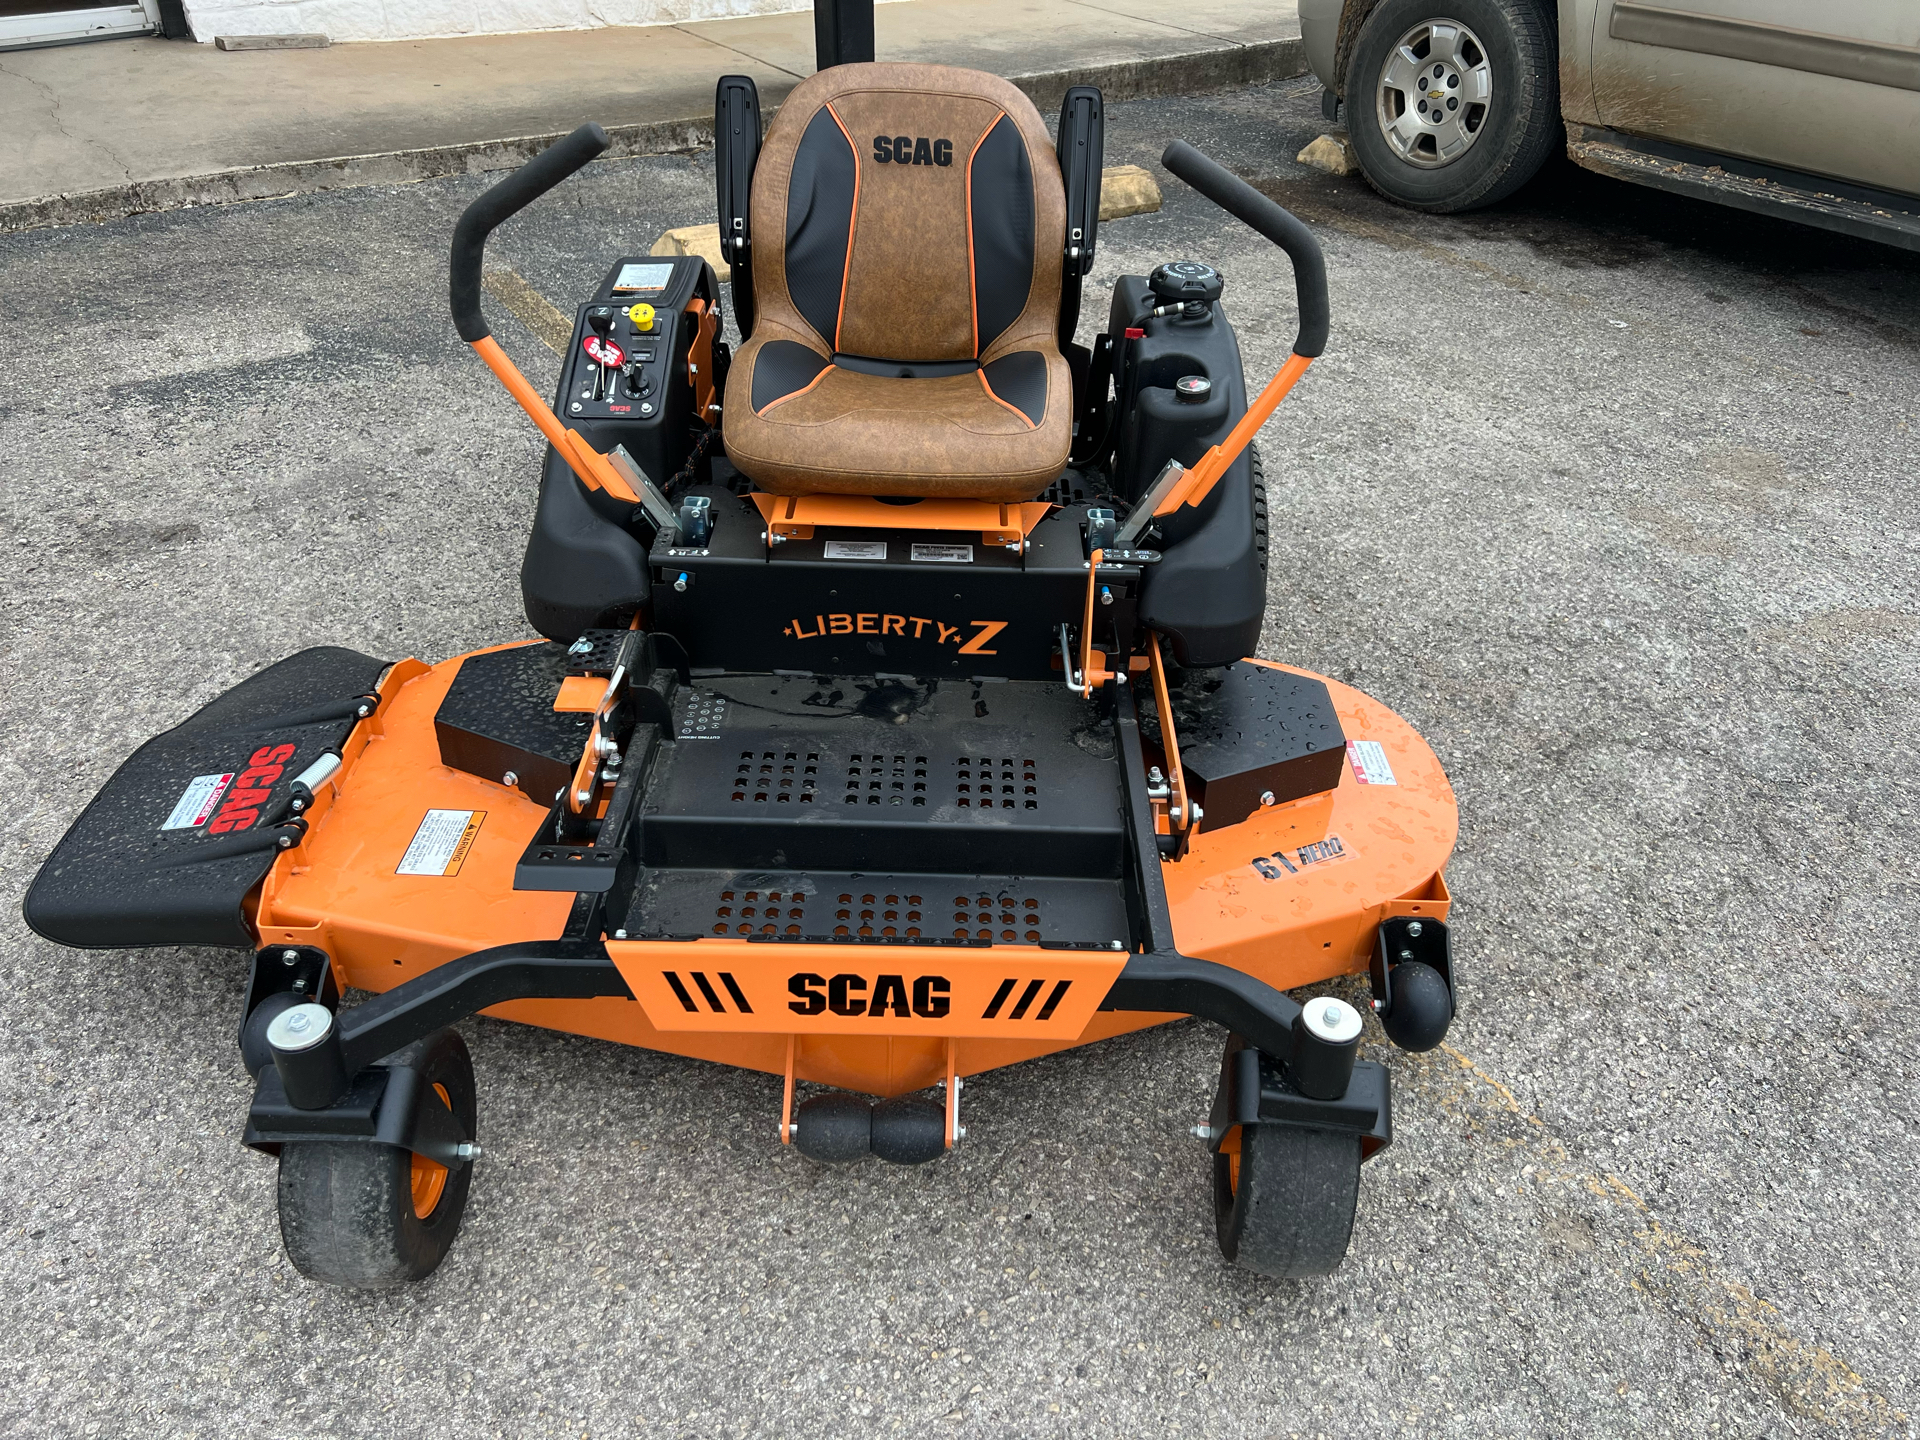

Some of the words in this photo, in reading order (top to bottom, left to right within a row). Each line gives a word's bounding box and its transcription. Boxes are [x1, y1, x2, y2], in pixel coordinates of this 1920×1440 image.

[874, 135, 953, 167] SCAG
[792, 613, 959, 645] LIBERTY
[958, 620, 1009, 655] Z
[198, 788, 222, 817] DANGER
[208, 743, 296, 834] SCAG
[452, 831, 473, 861] WARNING
[1252, 851, 1299, 879] 61
[1297, 837, 1344, 865] HERO
[788, 972, 951, 1018] SCAG
